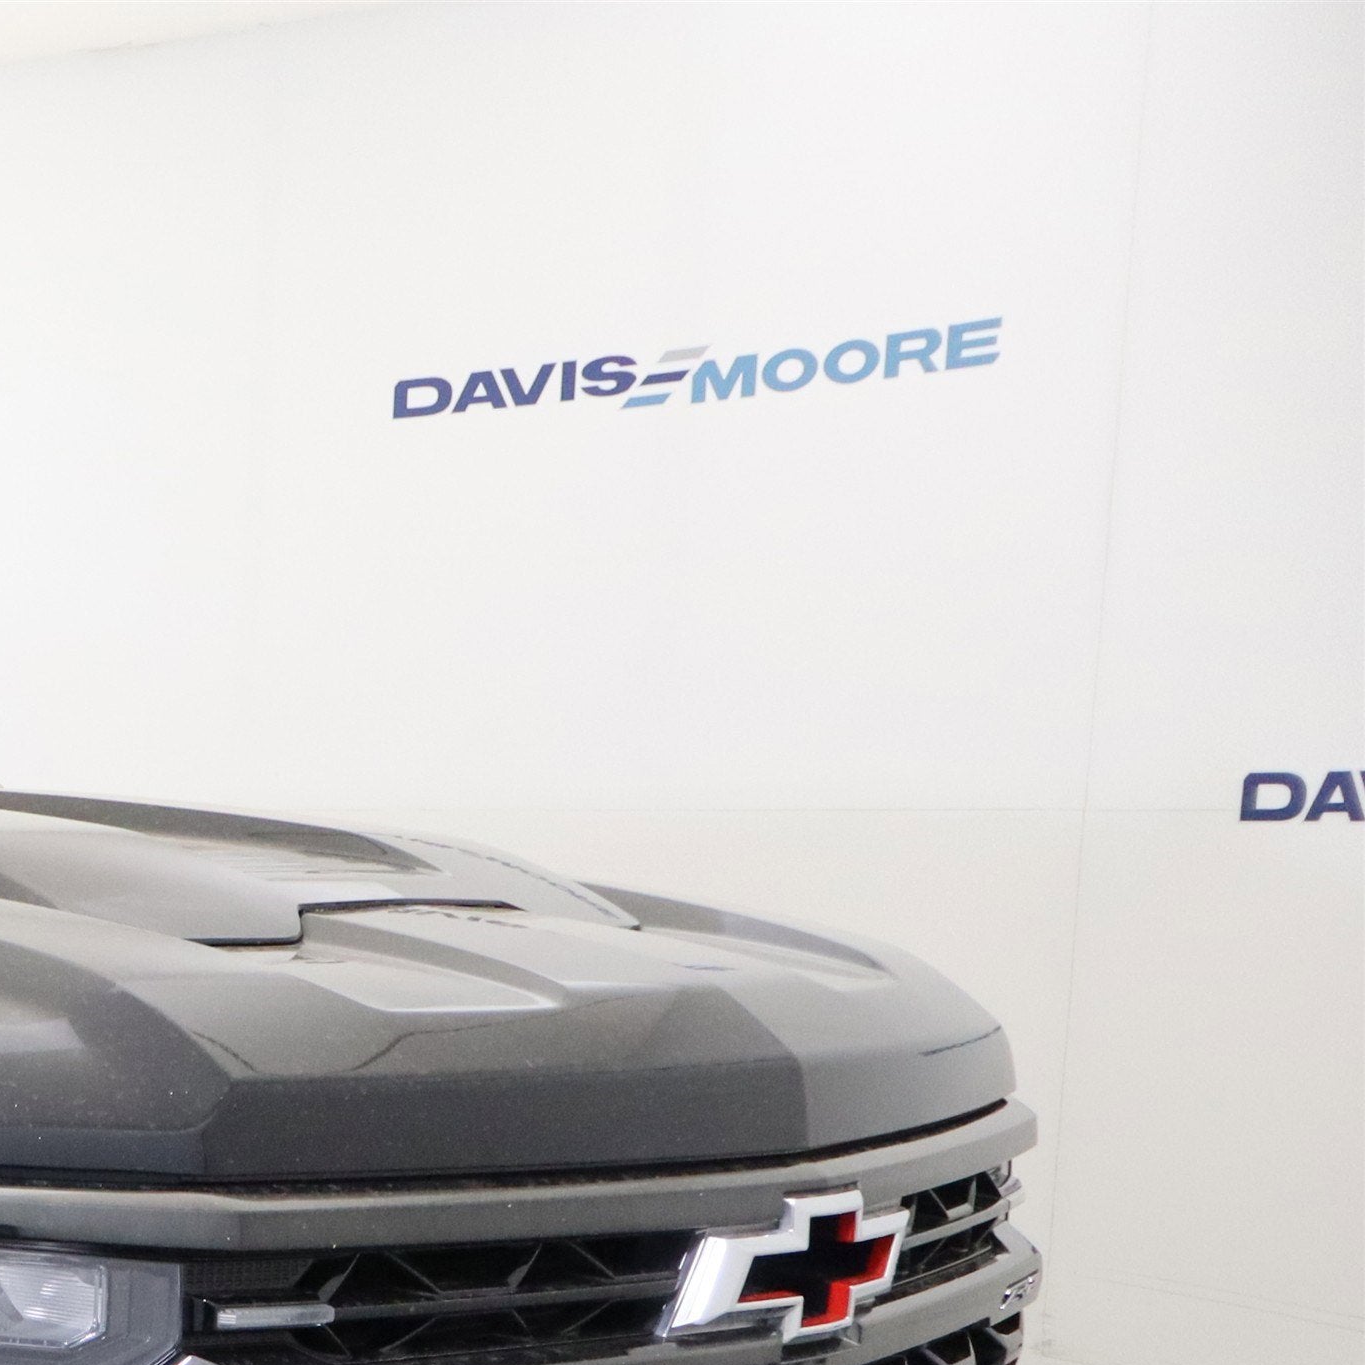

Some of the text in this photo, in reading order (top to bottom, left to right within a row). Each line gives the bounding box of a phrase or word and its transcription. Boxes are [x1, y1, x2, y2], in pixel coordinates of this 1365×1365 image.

[392, 316, 1003, 420] DAVIS MOORE
[1239, 770, 1365, 822] DA
